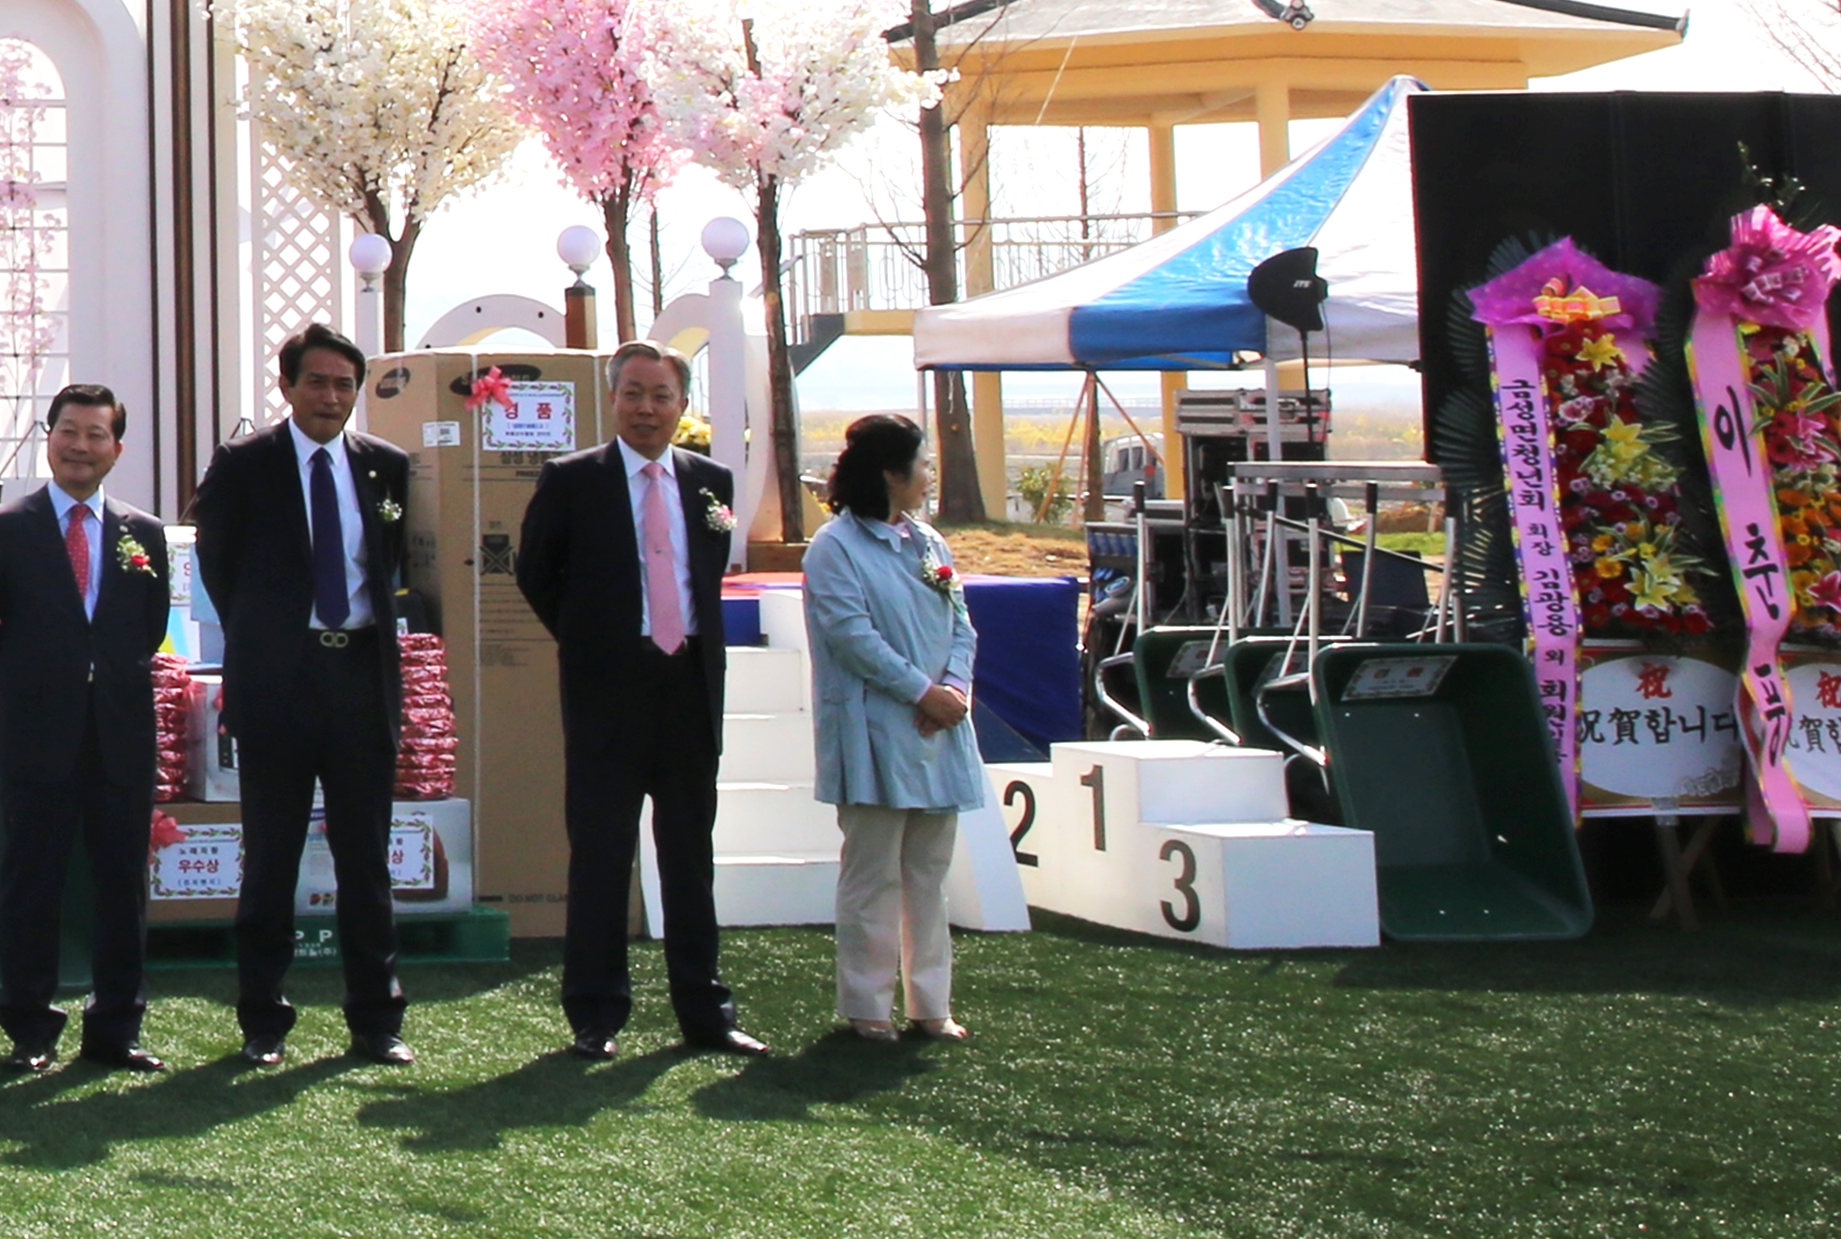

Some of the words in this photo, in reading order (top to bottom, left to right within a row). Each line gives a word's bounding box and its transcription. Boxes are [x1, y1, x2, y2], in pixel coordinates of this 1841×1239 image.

[1635, 663, 1673, 700] 祝
[1003, 780, 1040, 868] 2
[1080, 764, 1107, 852] 1
[178, 858, 220, 874] 우수상
[1159, 839, 1201, 933] 3
